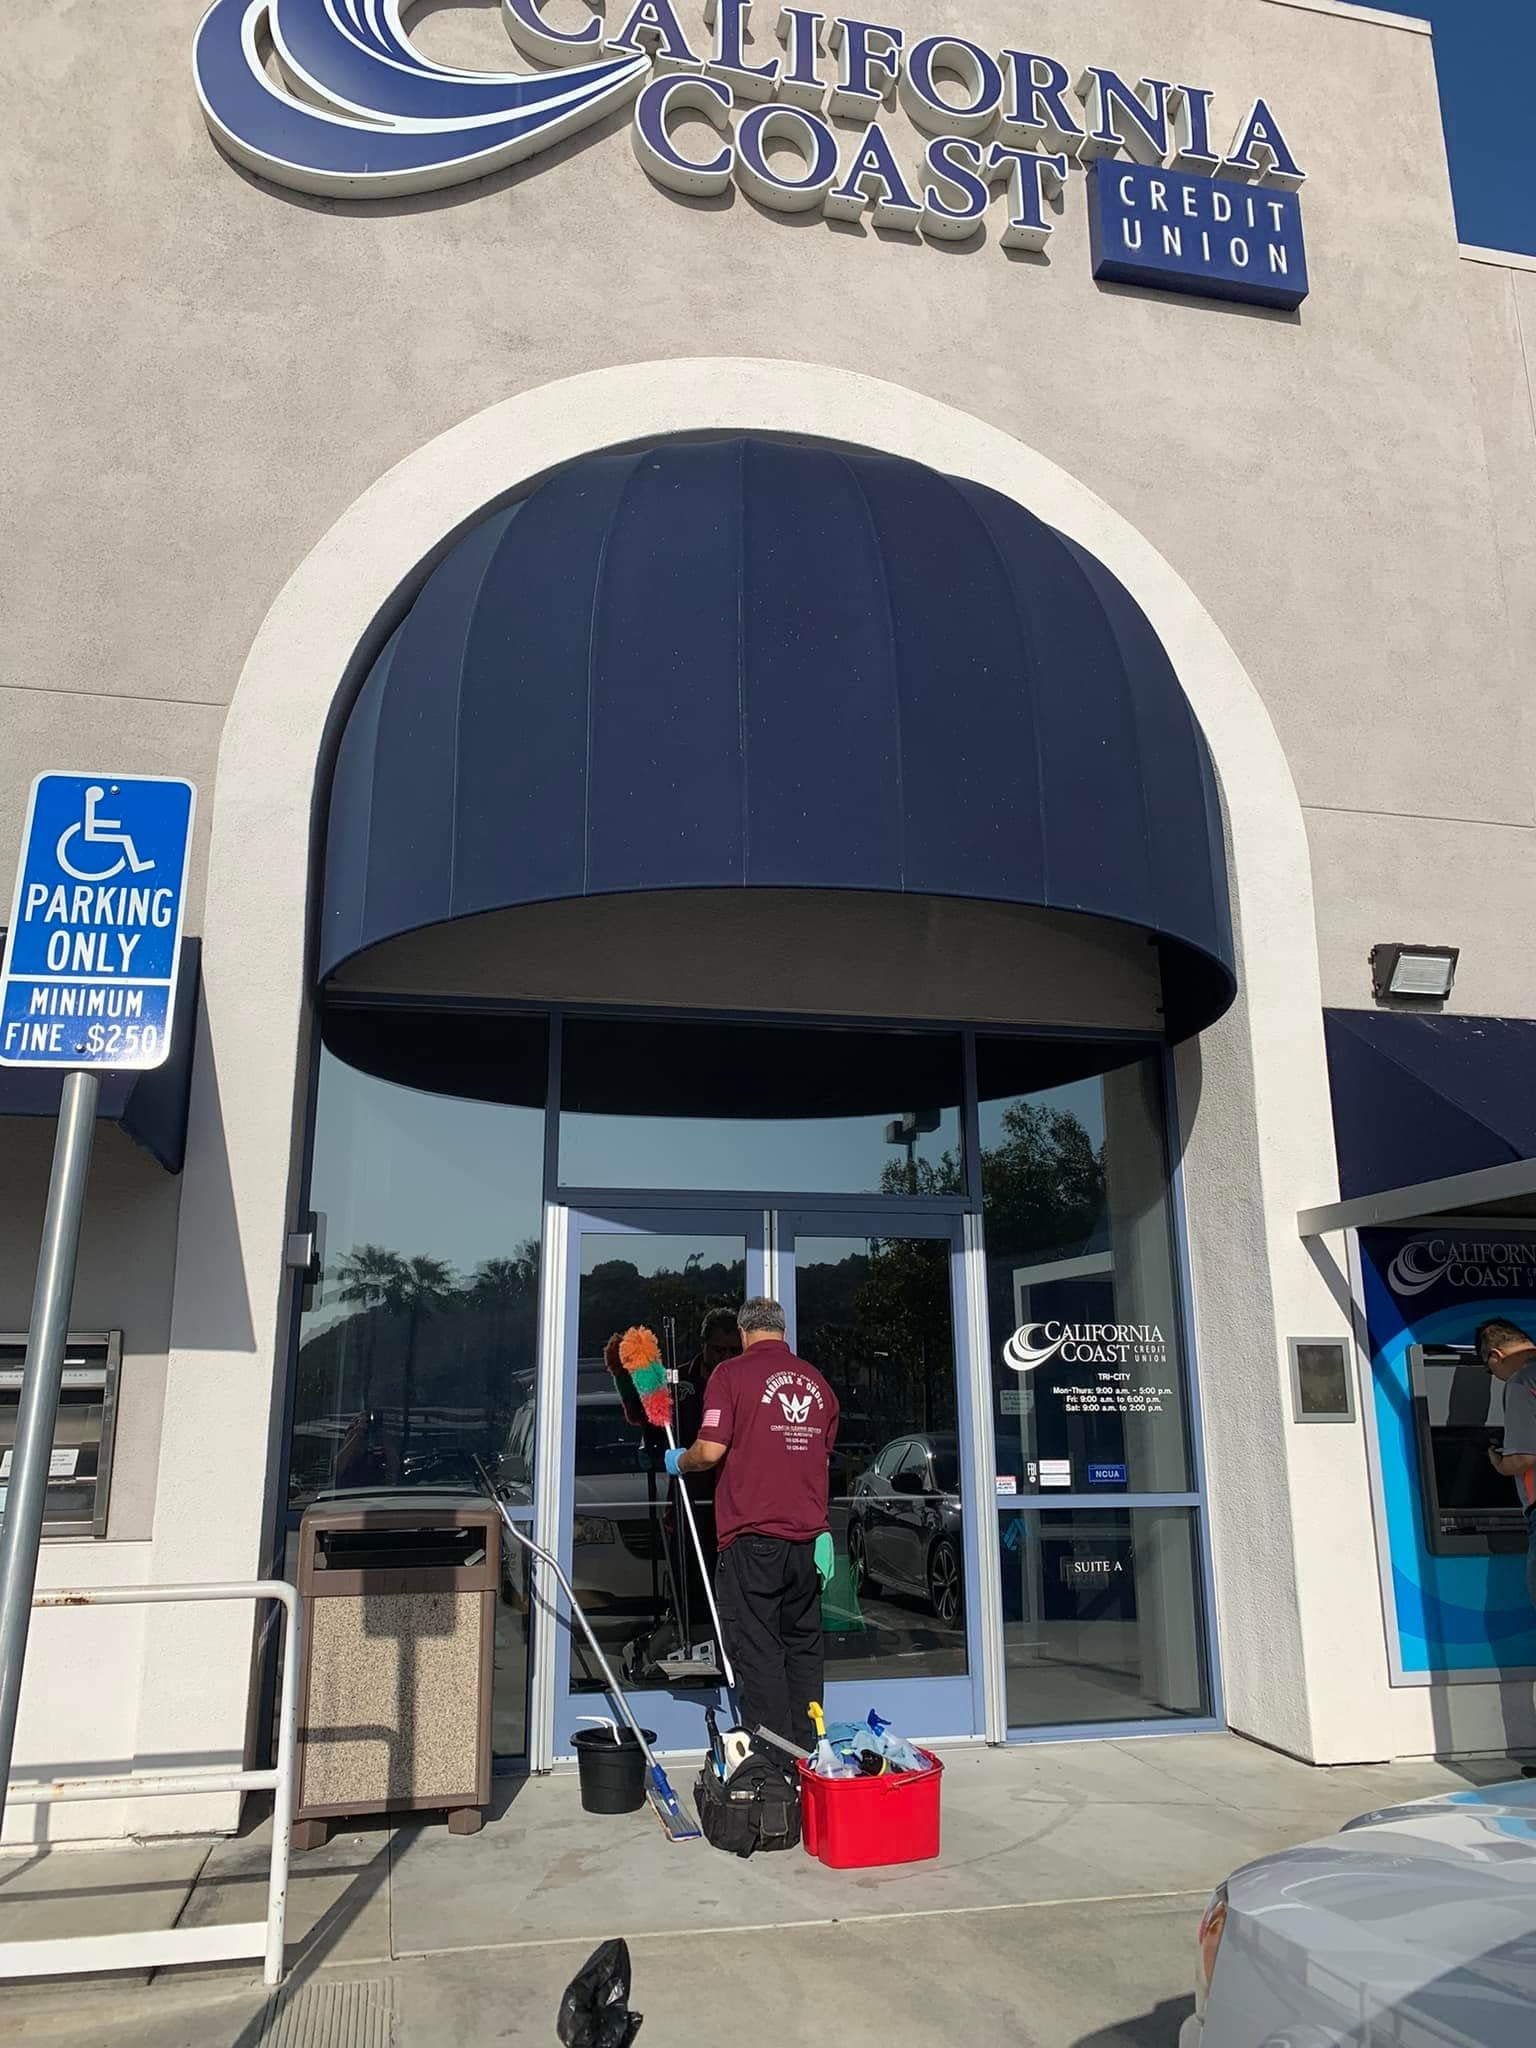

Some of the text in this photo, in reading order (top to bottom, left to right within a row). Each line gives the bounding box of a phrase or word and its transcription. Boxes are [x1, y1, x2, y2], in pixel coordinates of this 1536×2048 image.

[634, 73, 1069, 232] COAST
[1119, 175, 1285, 232] CREDIT
[1122, 217, 1288, 275] UNION
[24, 883, 174, 928] PARKING
[46, 930, 141, 973] ONLY
[29, 986, 144, 1018] MINIMUM
[4, 1022, 157, 1056] FINE $250
[1446, 1262, 1522, 1287] COAST
[1044, 1321, 1166, 1343] CALIFORNIA
[1060, 1341, 1131, 1363] COAST
[1133, 1344, 1166, 1354] CREDIT
[1134, 1354, 1167, 1363] UNION
[1097, 1372, 1132, 1381] TRI-CITY
[1080, 1395, 1098, 1403] 9:00
[1116, 1395, 1125, 1403] to
[1096, 1386, 1114, 1395] 9:00
[1082, 1403, 1100, 1412] 9:00
[1119, 1403, 1127, 1412] to
[1129, 1403, 1146, 1412] 2:00
[1095, 1470, 1120, 1479] NCUA
[1074, 1560, 1123, 1573] SUITE A
